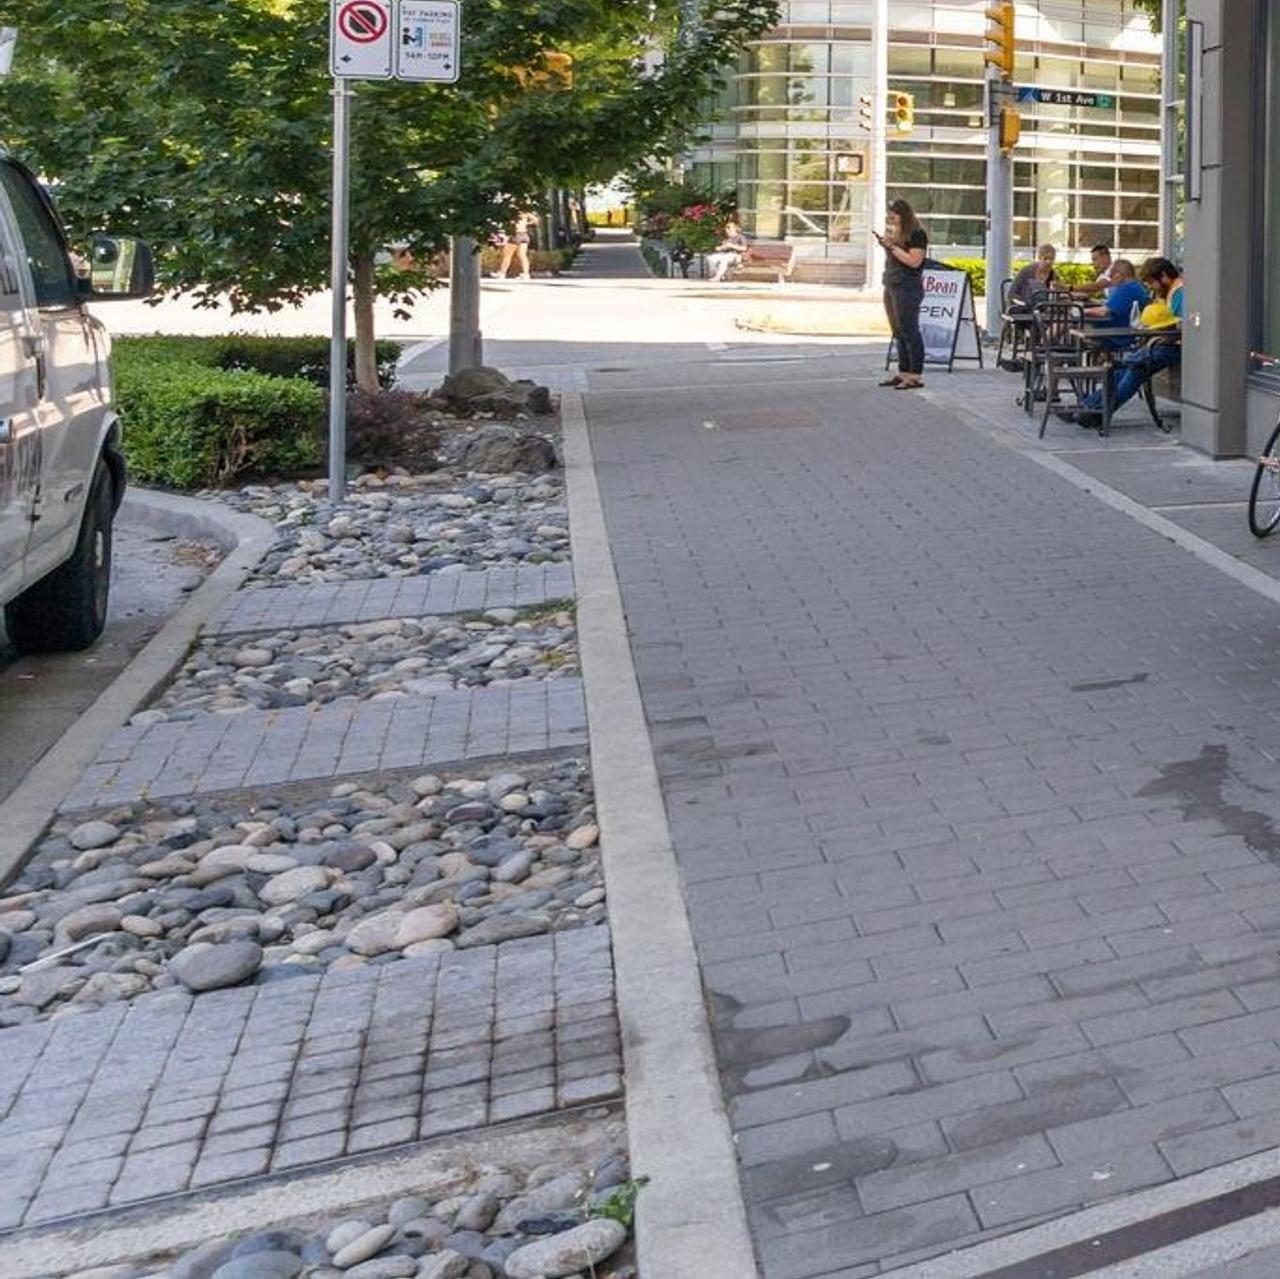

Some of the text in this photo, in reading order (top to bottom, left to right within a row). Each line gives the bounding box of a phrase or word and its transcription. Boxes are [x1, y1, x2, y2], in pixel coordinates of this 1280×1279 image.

[1041, 92, 1095, 105] W 1st Ave
[926, 276, 957, 293] Bean
[917, 306, 955, 318] PEN
